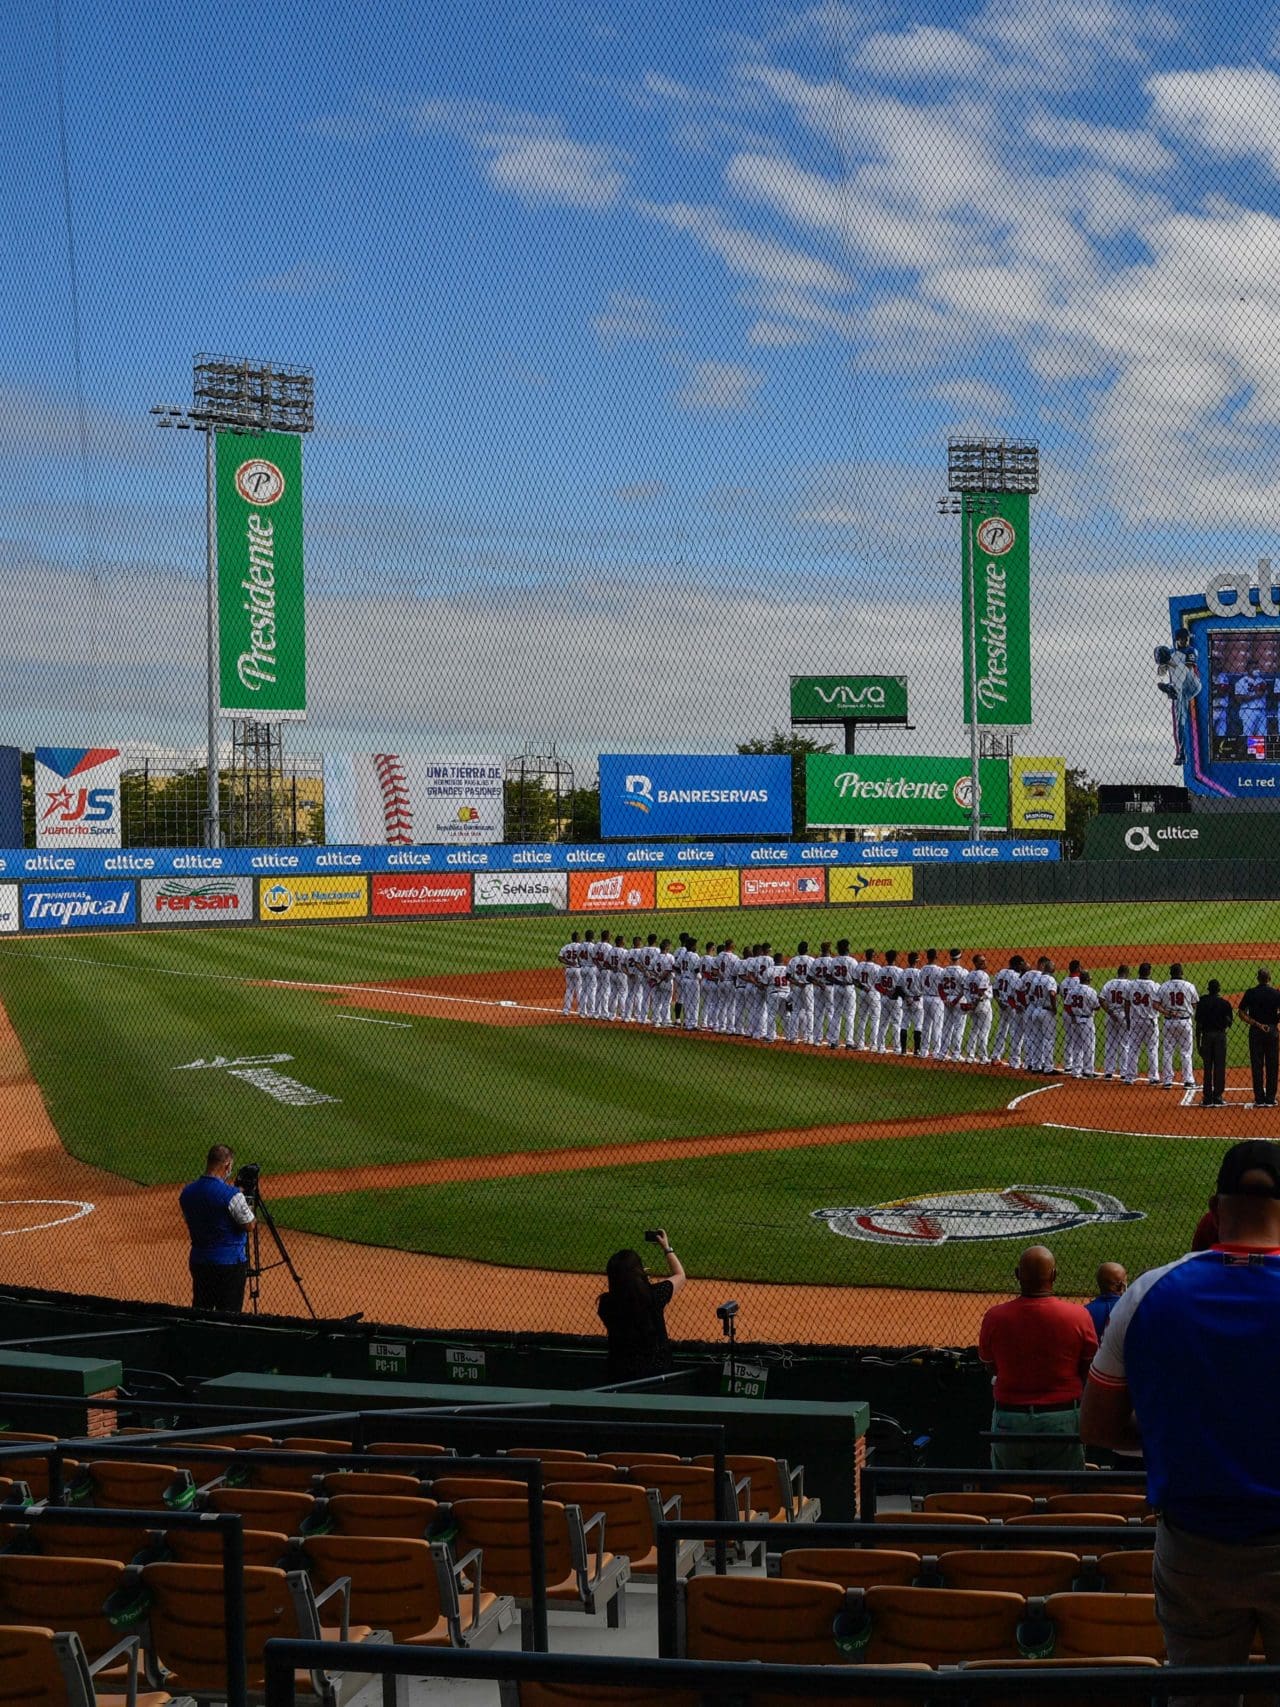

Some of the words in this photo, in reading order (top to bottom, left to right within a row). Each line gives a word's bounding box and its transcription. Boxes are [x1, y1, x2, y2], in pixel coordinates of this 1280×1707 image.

[237, 513, 277, 691] Presidente
[977, 563, 1008, 709] Presidente
[426, 767, 448, 778] UNA
[450, 767, 486, 779] TIERRA
[487, 768, 501, 779] DE
[833, 772, 948, 801] Presidente
[1238, 777, 1253, 787] La
[1256, 777, 1275, 787] red
[427, 787, 462, 796] GRANDES
[465, 787, 501, 796] PASIONES
[657, 789, 768, 803] BANRESERVAS
[60, 788, 115, 821] JS
[40, 825, 89, 836] Juancito
[90, 826, 117, 836] Sport
[1156, 826, 1199, 839] altice
[446, 850, 488, 864] altice
[513, 850, 552, 863] altice
[566, 849, 605, 863] altice
[627, 848, 664, 862] altice
[678, 848, 714, 861] altice
[750, 847, 788, 860] altice
[801, 847, 839, 859] altice
[862, 845, 898, 858] altice
[912, 845, 949, 857] altice
[962, 845, 999, 857] altice
[1012, 844, 1049, 857] altice
[25, 855, 76, 870] altice
[105, 855, 155, 869] altice
[173, 854, 223, 869] altice
[252, 853, 299, 868] altice
[316, 852, 362, 866] altice
[387, 851, 431, 864] altice
[48, 892, 86, 900] PINTURAS
[311, 890, 361, 900] Nacional
[387, 886, 420, 899] Santo
[421, 886, 467, 900] Domingo
[502, 884, 549, 895] SeNaSa
[27, 891, 130, 925] Tropical
[155, 894, 239, 912] Fersan
[1133, 991, 1150, 1007] 34
[376, 1345, 387, 1355] LTB
[453, 1352, 465, 1362] LTB
[375, 1360, 398, 1372] PC-11
[453, 1366, 478, 1379] PC-10
[736, 1365, 746, 1377] TB
[728, 1380, 759, 1395] C-09
